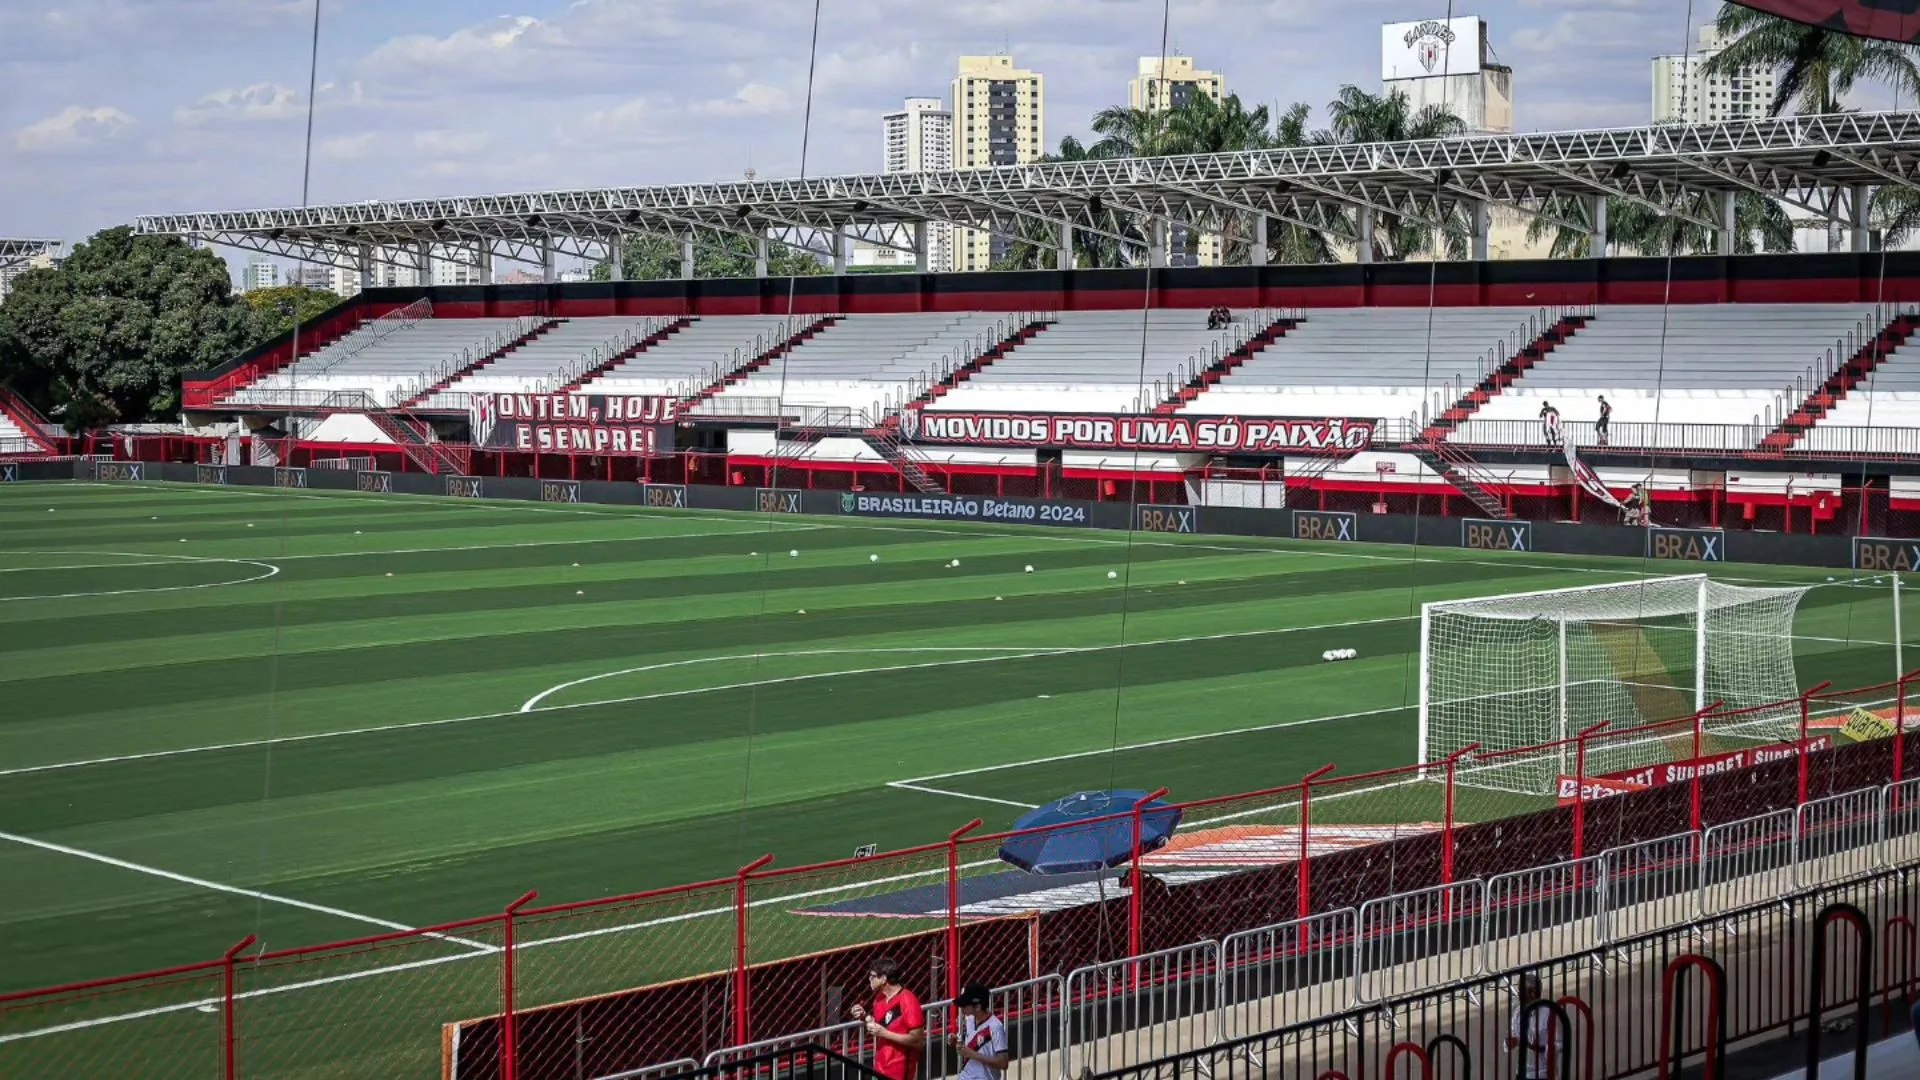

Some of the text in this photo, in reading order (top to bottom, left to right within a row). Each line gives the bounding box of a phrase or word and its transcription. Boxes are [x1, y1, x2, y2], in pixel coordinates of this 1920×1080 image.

[499, 394, 677, 422] ONTEM, HOJE
[518, 427, 654, 452] E SEMPRE!
[923, 416, 1368, 448] MOVIDOS POR UMA SÓ PAIXÃO
[101, 465, 139, 480] BRAX
[361, 476, 388, 492] BRAX
[449, 480, 480, 498] BRAX
[544, 484, 576, 503] BRAX
[648, 488, 682, 507] BRAX
[760, 493, 798, 512] BRAX
[858, 497, 1085, 522] BRASILEIRÃO Betano 2024
[1142, 510, 1190, 533] BRAX
[1299, 516, 1350, 540] BRAX
[1468, 524, 1524, 551] BRAX
[1655, 534, 1717, 561] BRAX
